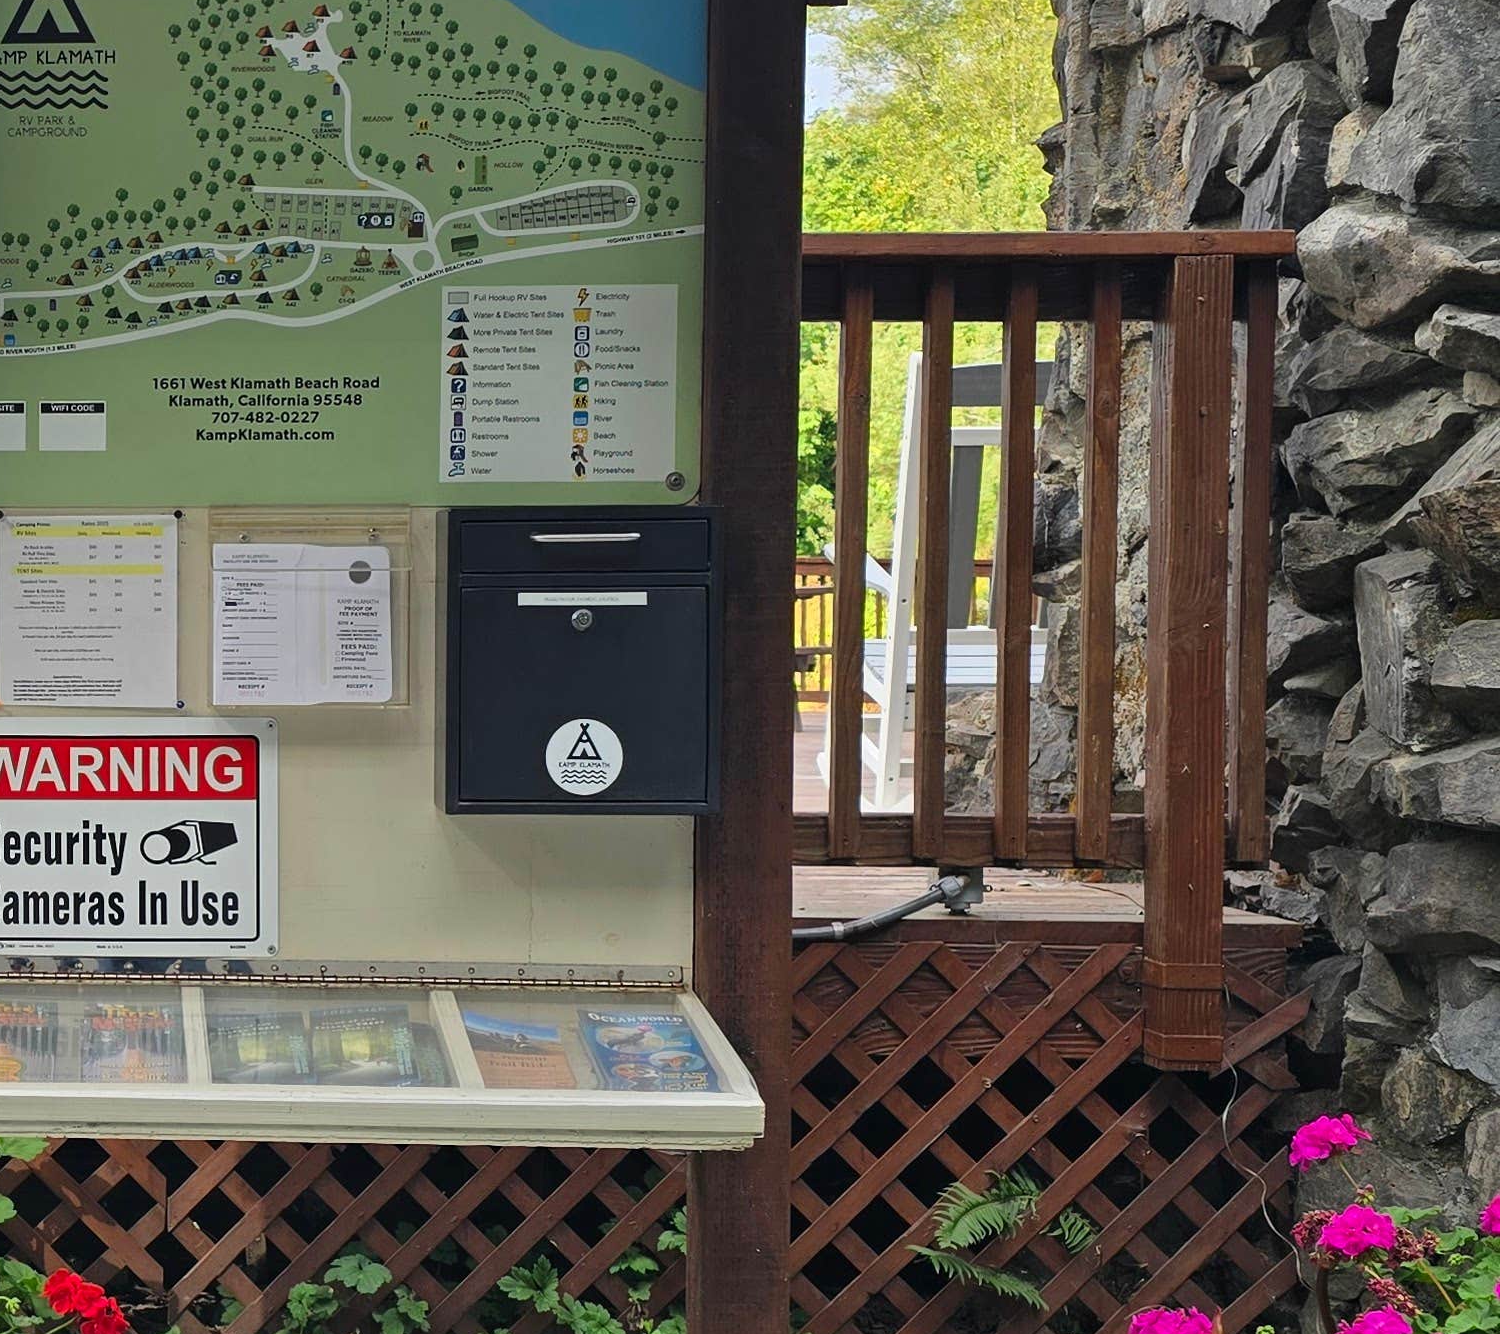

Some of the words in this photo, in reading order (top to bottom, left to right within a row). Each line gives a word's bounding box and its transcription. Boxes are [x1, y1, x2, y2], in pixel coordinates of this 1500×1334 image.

[37, 50, 116, 65] KLAMATH
[19, 115, 34, 125] RV
[37, 115, 64, 125] PARK
[68, 115, 76, 125] &
[7, 126, 87, 138] CAMPGROUND
[473, 294, 487, 302] Full
[488, 294, 515, 302] Hookup
[596, 293, 630, 301] Electricity
[473, 311, 494, 319] Water
[495, 311, 501, 319] &
[503, 311, 529, 319] Electric
[595, 310, 616, 318] Trash
[473, 329, 491, 337] More
[492, 328, 517, 336] Private
[519, 328, 534, 336] Tent
[535, 328, 553, 336] Sites
[595, 328, 624, 338] Laundry
[473, 346, 500, 354] Remote
[595, 345, 641, 353] Food/Snacks
[506, 363, 521, 371] Tent
[522, 363, 540, 371] Sites
[595, 362, 616, 370] Picnic
[153, 378, 185, 390] 1661
[190, 377, 227, 389] West
[231, 377, 290, 389] Klamath
[295, 377, 338, 389] Beach
[343, 376, 379, 389] Road
[611, 380, 642, 389] Cleaning
[644, 379, 668, 387] Station
[169, 394, 234, 409] Klamath,
[238, 394, 309, 406] California
[313, 394, 362, 406] 95548
[472, 398, 493, 407] Dump
[495, 398, 519, 406] Station
[594, 398, 616, 406] Hiking
[51, 404, 69, 412] WIFI
[71, 404, 95, 412] CODE
[212, 411, 319, 424] 707-482-0227
[471, 415, 501, 423] Portable
[502, 415, 540, 423] Restrooms
[196, 428, 334, 443] KampKlamath.com
[471, 433, 509, 441] Restrooms
[593, 432, 616, 440] Beach
[471, 450, 498, 458] Shower
[593, 449, 633, 458] Playground
[139, 881, 167, 925] In
[181, 880, 239, 926] Use
